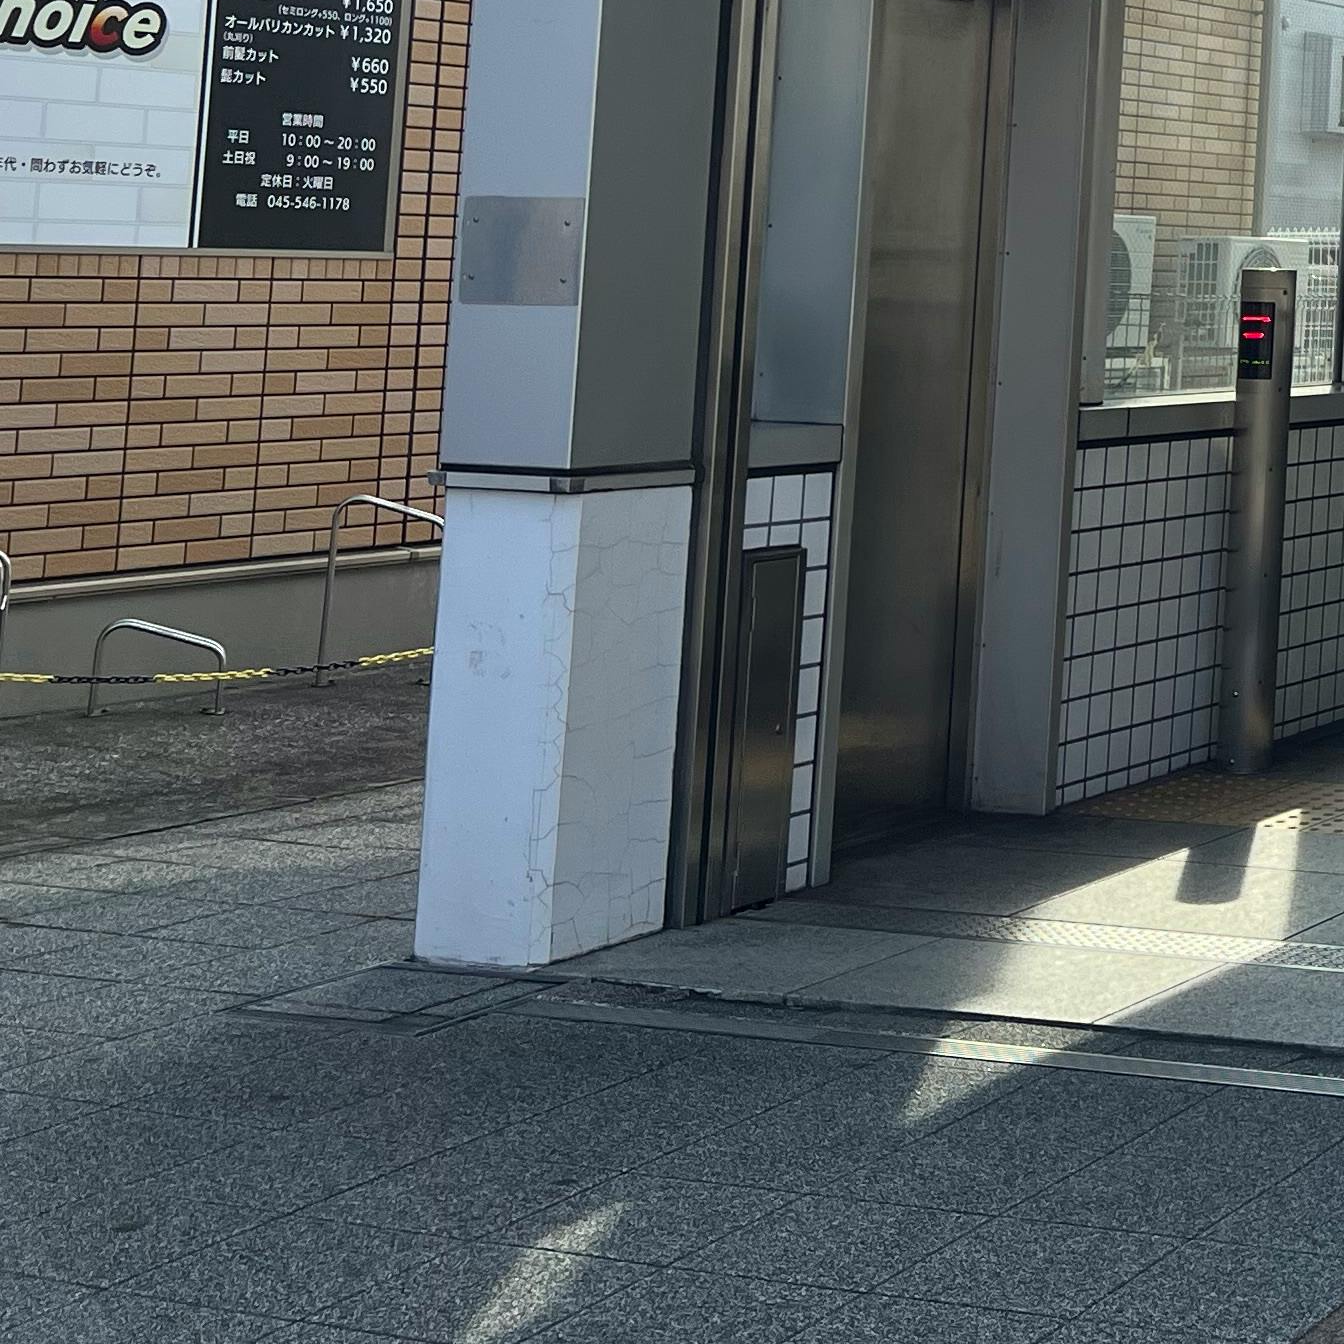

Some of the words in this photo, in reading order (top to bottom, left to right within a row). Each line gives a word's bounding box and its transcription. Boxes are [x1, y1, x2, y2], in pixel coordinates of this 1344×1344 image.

[225, 14, 336, 39] オールバリカンカット
[340, 24, 392, 45] ¥1,320
[351, 56, 389, 75] ¥660
[350, 77, 388, 95] ¥550
[282, 112, 324, 129] 営業時間
[227, 129, 250, 145] 平日
[222, 150, 256, 166] 土日祝
[235, 193, 258, 208] 電話
[267, 194, 350, 211] 045-546-1178
